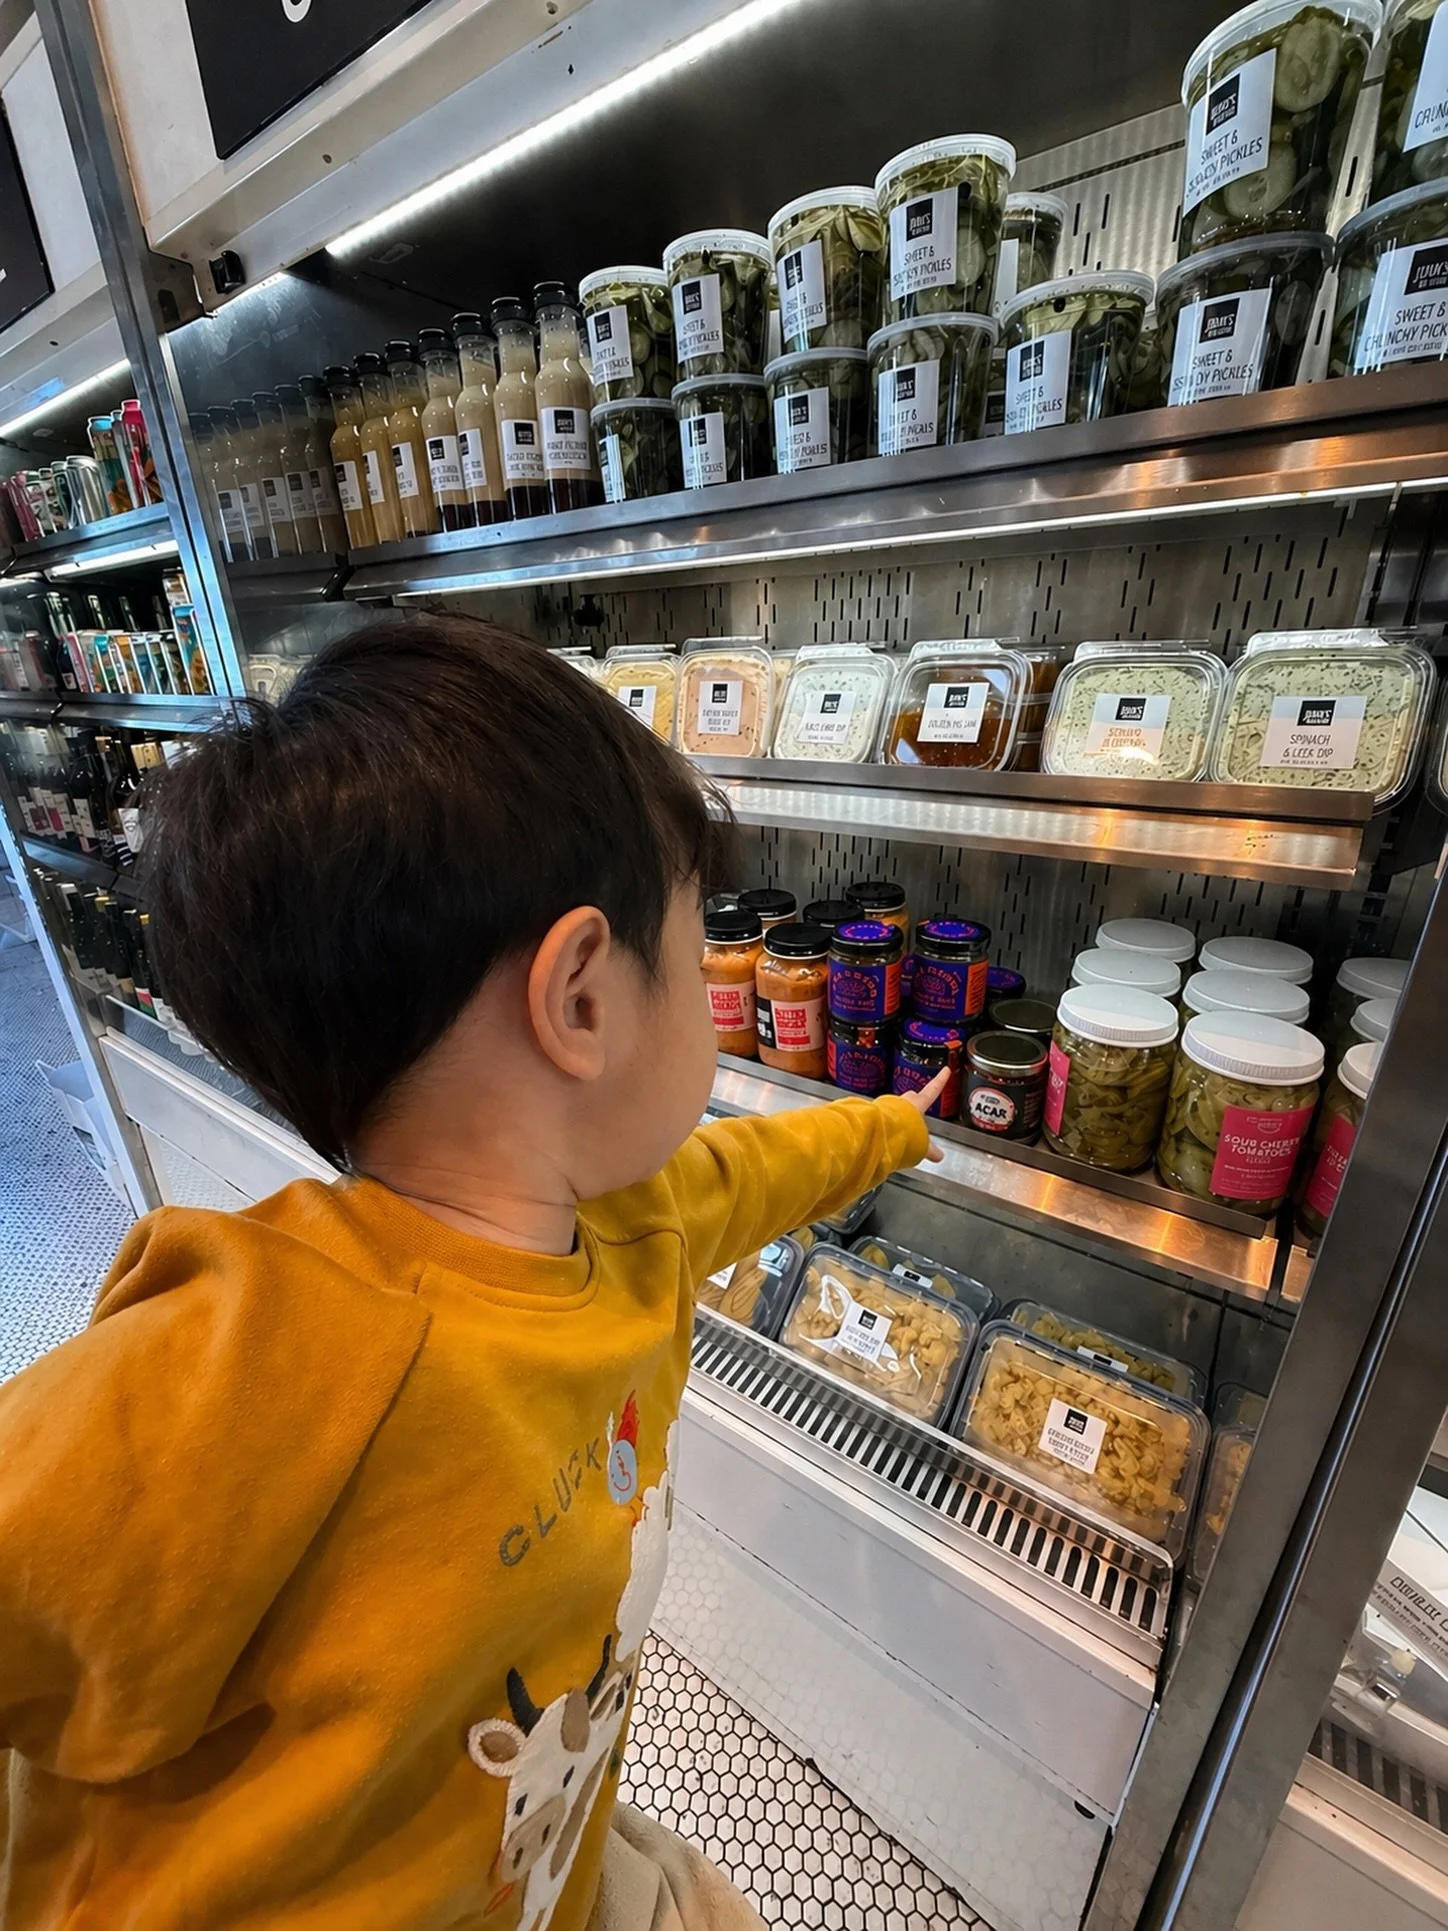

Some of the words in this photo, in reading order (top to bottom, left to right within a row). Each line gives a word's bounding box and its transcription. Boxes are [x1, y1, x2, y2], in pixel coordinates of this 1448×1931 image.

[1220, 136, 1263, 171] PICKLES
[1395, 303, 1436, 325] SWEET
[1193, 350, 1225, 370] SWEET
[1212, 363, 1254, 383] PICKLES
[1289, 734, 1331, 746] SPINACH
[1292, 747, 1314, 758] LEEK
[1316, 747, 1334, 758] DIP
[975, 1103, 1007, 1119] ACAR
[1224, 1134, 1257, 1147] SOUR
[1231, 1145, 1292, 1157] TOMATOES
